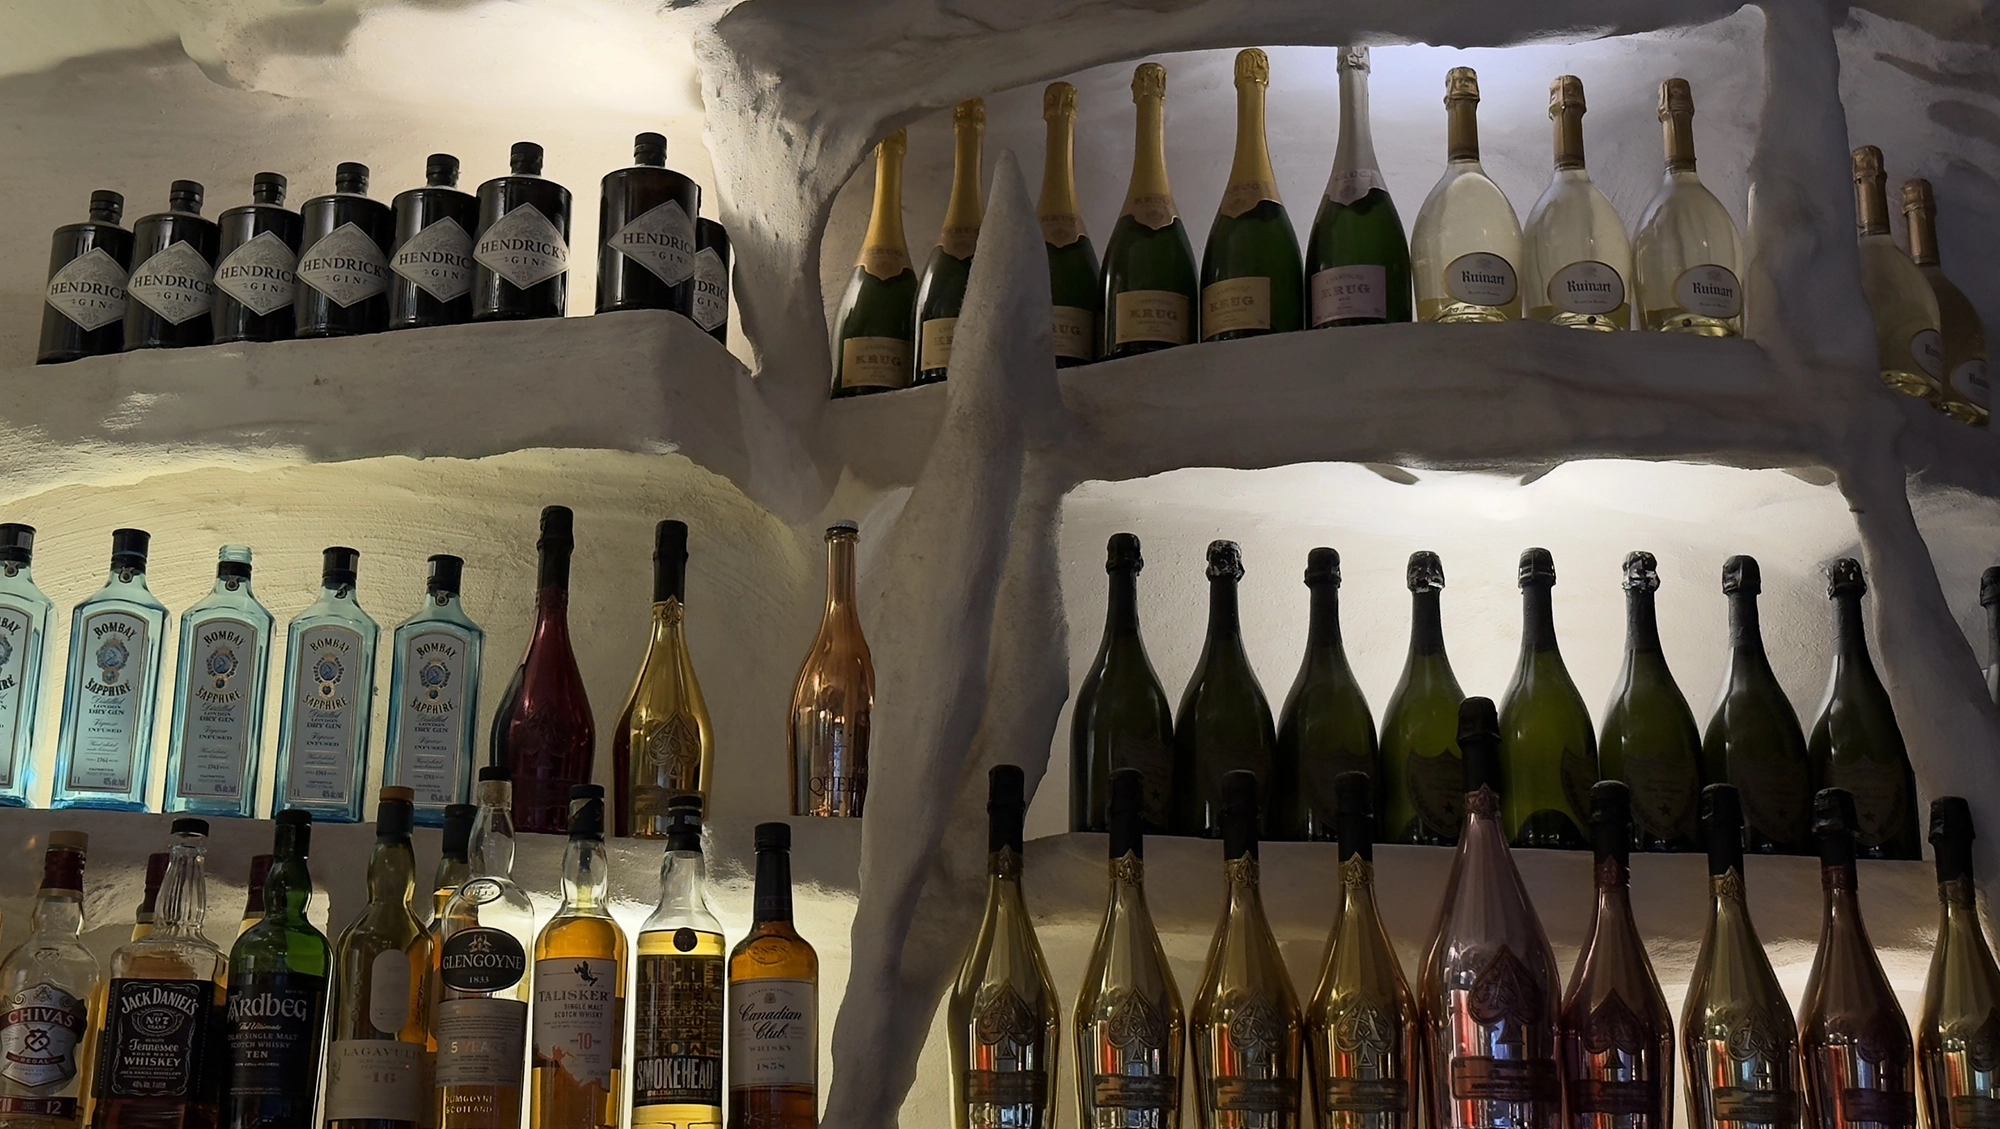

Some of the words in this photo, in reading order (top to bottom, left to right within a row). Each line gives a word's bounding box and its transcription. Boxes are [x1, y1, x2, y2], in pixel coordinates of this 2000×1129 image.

[480, 238, 567, 263] HENDRICK'S
[399, 252, 471, 269] HENDRIC
[511, 256, 539, 266] GIN
[658, 251, 683, 264] GIN
[332, 274, 361, 285] GIN
[431, 269, 459, 280] GIN
[1461, 270, 1505, 286] Ruinart
[133, 275, 213, 296] HENDRICK
[250, 282, 279, 293] GIN
[1320, 283, 1371, 299] KRUG
[1566, 280, 1612, 293] Ruinart
[1692, 281, 1734, 298] Ruinart
[78, 298, 107, 309] GIN
[163, 291, 195, 303] GIN
[697, 297, 719, 309] GIN
[1209, 295, 1255, 312] KRUG
[1129, 308, 1178, 321] KRUG
[855, 354, 902, 367] KRUG
[93, 622, 137, 641] BOMBAY
[204, 630, 246, 649] BOMBAY
[309, 637, 351, 656] BOMBAY
[416, 642, 458, 661] BOMBAY
[84, 677, 133, 697] SAPPHIRE
[195, 685, 242, 704] SAPPHIRE
[302, 692, 347, 711] SAPPHIRE
[409, 697, 455, 716] SAPPHIRE
[442, 953, 523, 970] GLENGOYNE
[469, 976, 489, 984] 1833
[121, 991, 152, 1014] JACK
[152, 987, 199, 1016] DANIEL'S
[538, 989, 610, 1002] TALISKER
[587, 1003, 603, 1011] MALT
[738, 1003, 803, 1021] Canadian
[8, 1008, 75, 1028] CHIVAS
[162, 1017, 170, 1025] 7
[579, 1011, 603, 1019] WHISKY
[244, 1032, 274, 1040] SINGLE
[276, 1033, 298, 1041] MALT
[578, 1032, 592, 1050] 10
[128, 1038, 180, 1052] Tennessee
[461, 1040, 508, 1055] YEARS
[749, 1044, 792, 1052] WHISKY
[245, 1050, 269, 1058] TEN
[343, 1047, 423, 1060] LAGAVULIN
[19, 1056, 50, 1065] REGAL
[123, 1056, 182, 1067] WHISKEY
[756, 1062, 786, 1071] 1858
[371, 1072, 396, 1084] 16
[636, 1057, 714, 1092] SMOKEHEAD
[46, 1101, 62, 1115] 12
